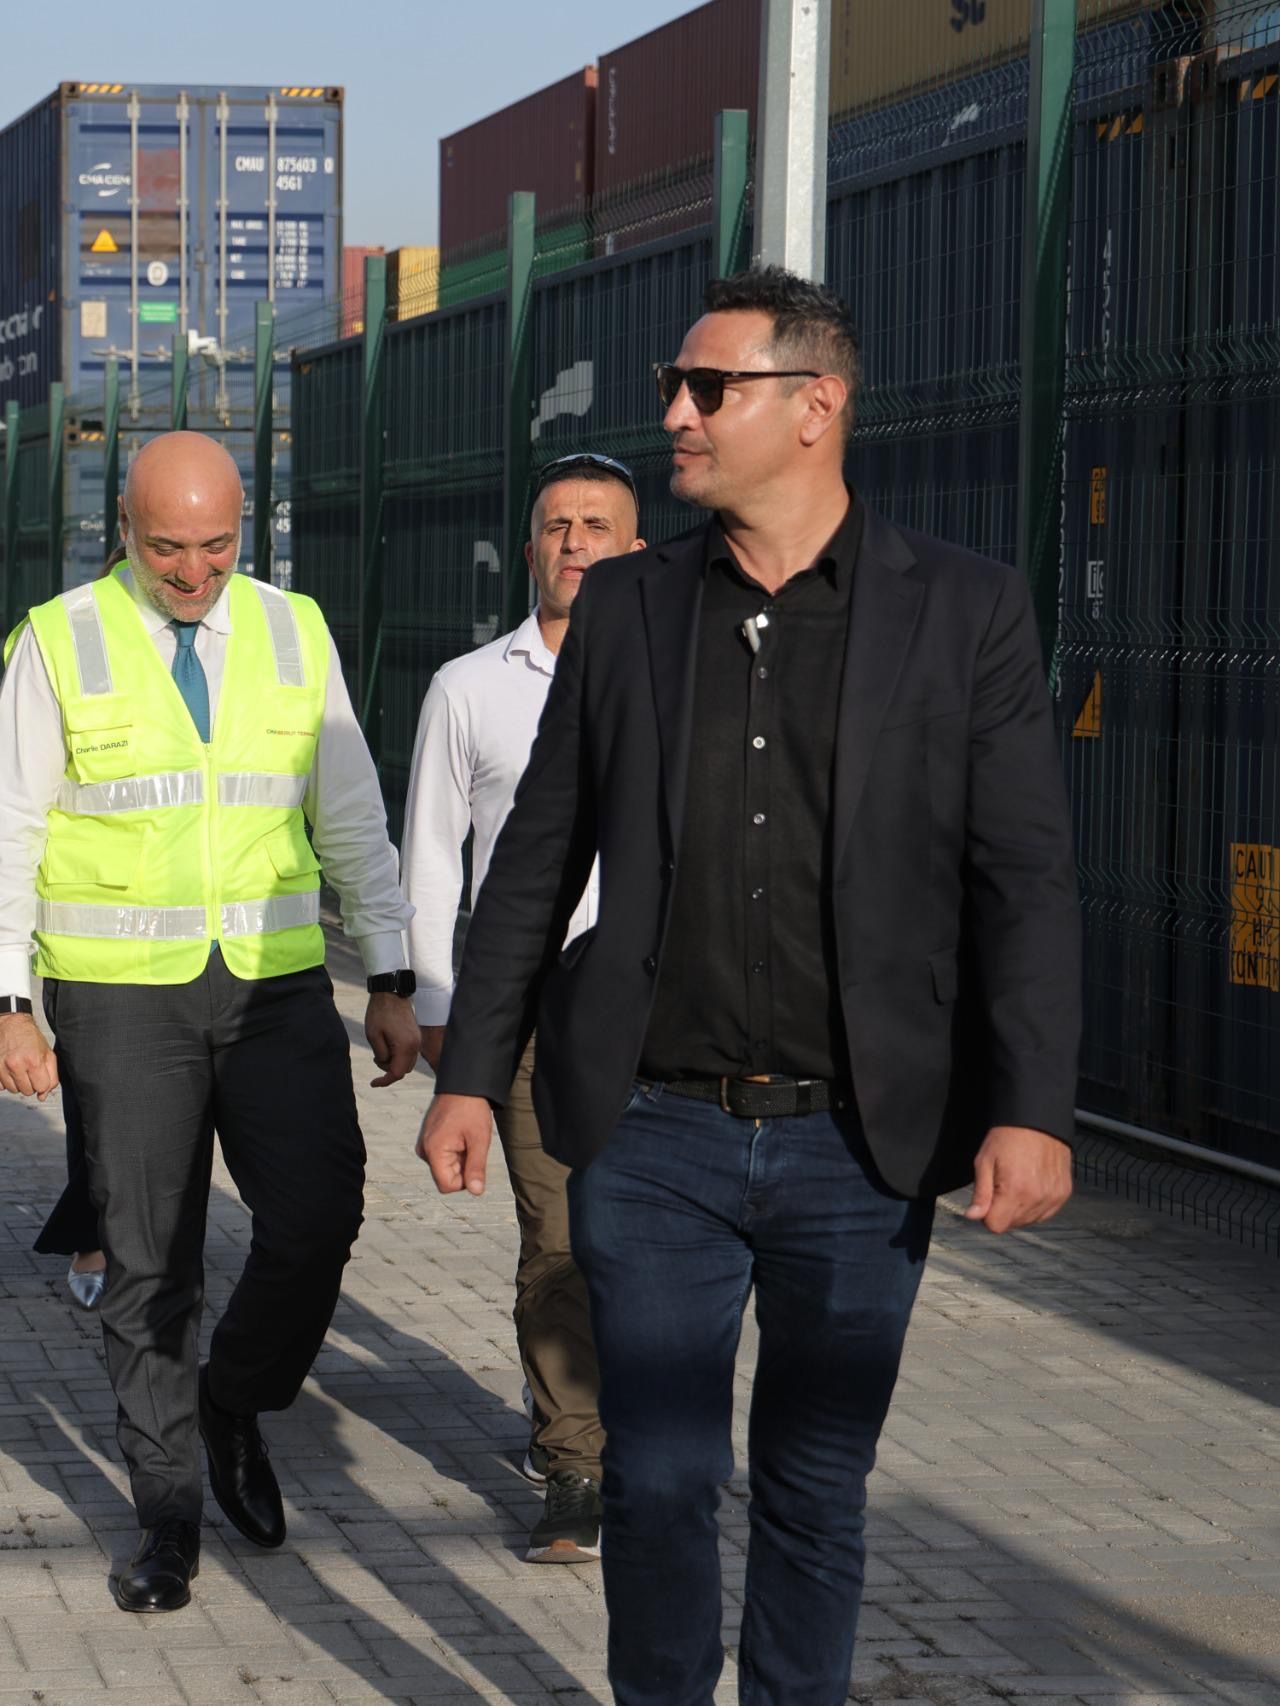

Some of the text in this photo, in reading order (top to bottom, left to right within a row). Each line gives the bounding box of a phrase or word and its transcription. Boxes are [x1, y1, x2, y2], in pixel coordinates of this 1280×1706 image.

[235, 156, 265, 172] CMAU
[277, 157, 317, 173] 875603
[276, 176, 302, 191] 45G1
[100, 740, 128, 751] DARAZI
